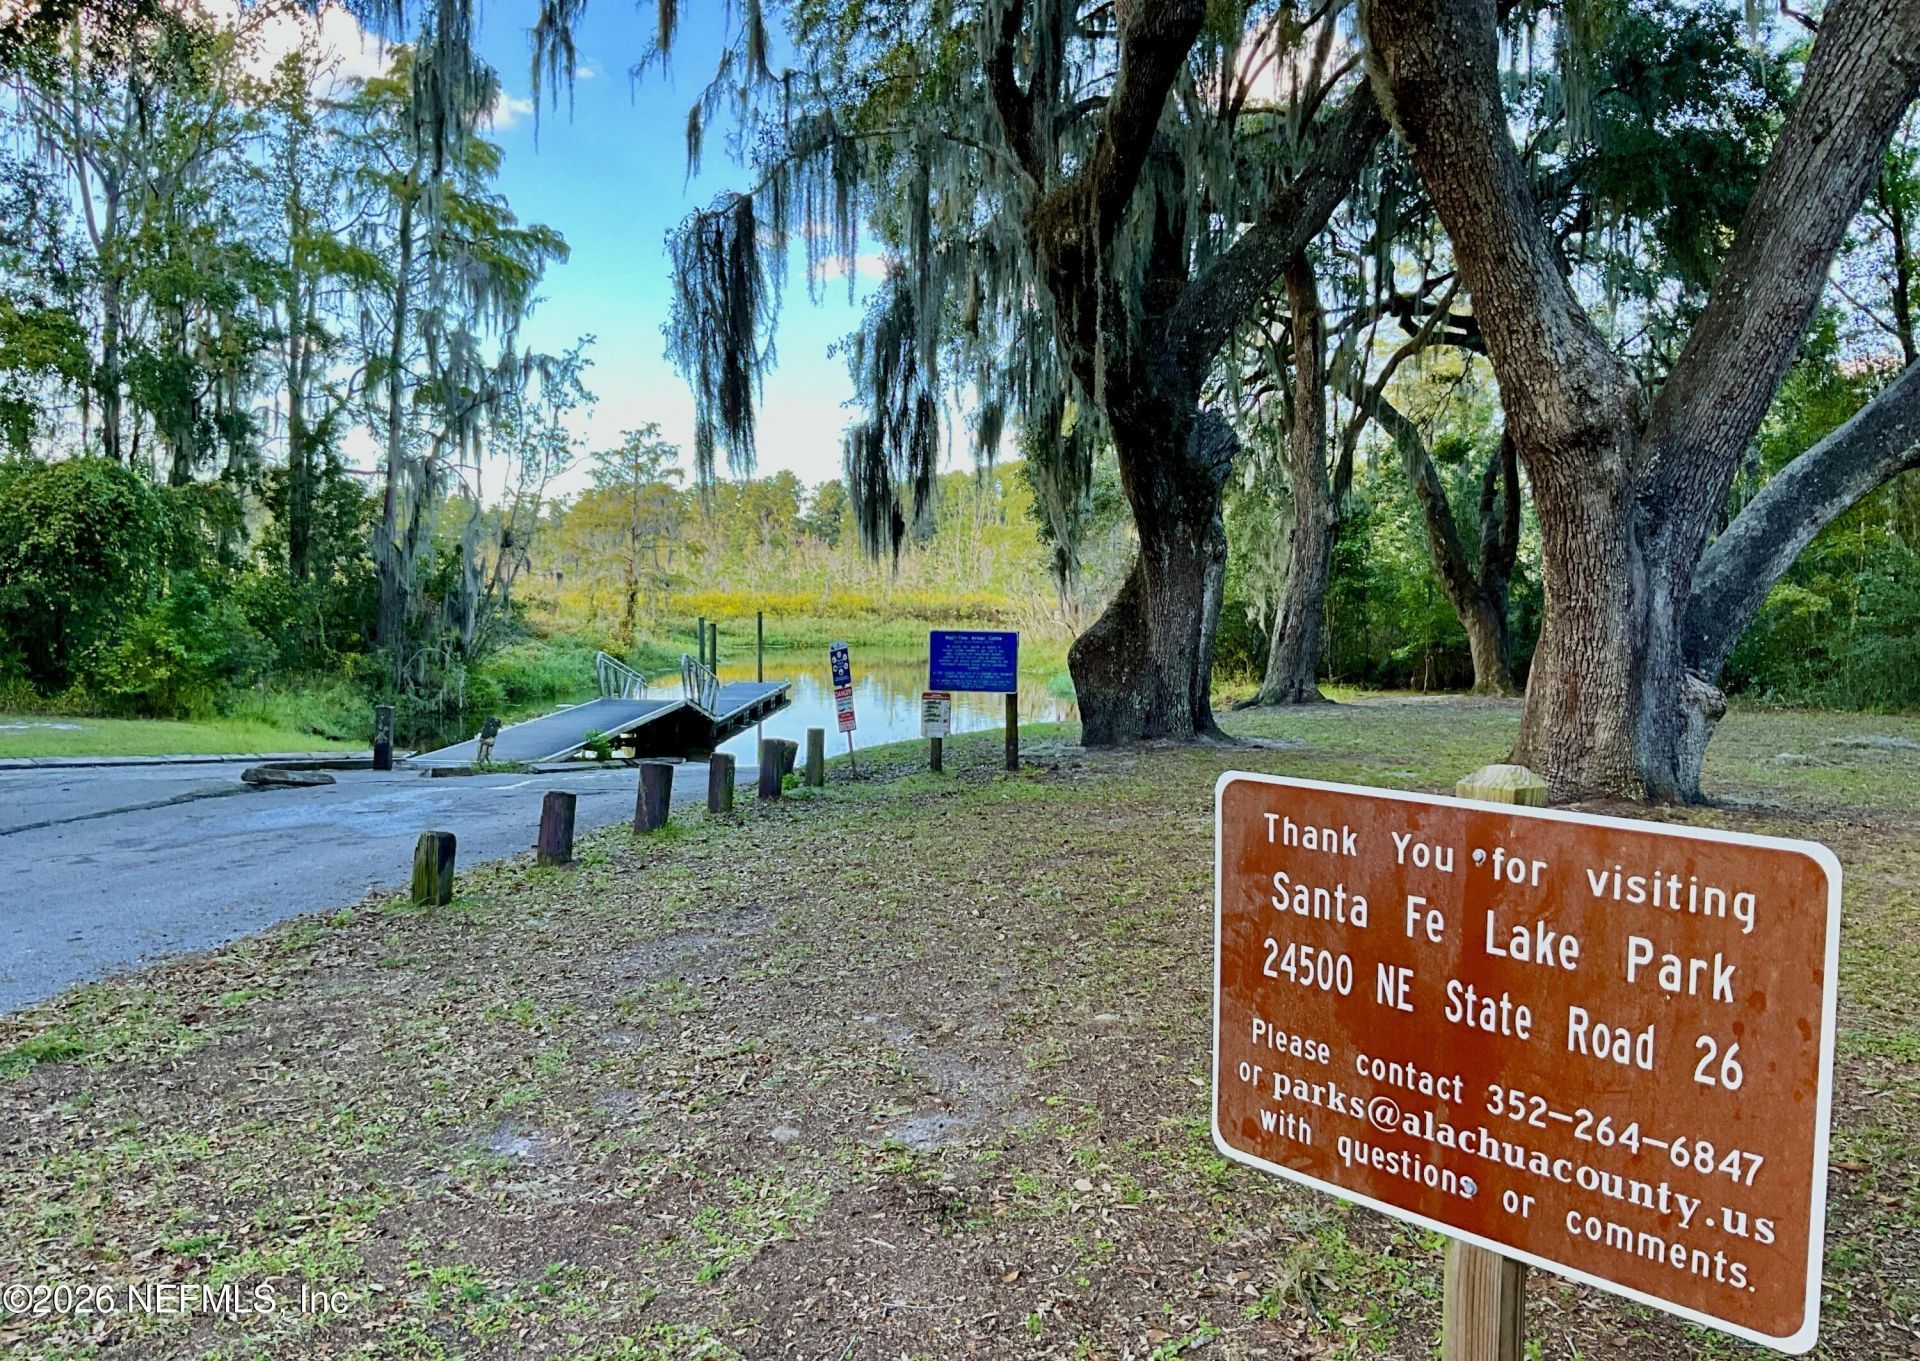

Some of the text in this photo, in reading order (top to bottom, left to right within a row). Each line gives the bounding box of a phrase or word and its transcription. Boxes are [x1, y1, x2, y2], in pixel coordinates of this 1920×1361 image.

[1264, 813, 1755, 934] Thank You for visiting
[1272, 872, 1736, 1003] Santa Fe Lake Park
[1252, 1017, 1330, 1064] Please
[1356, 1055, 1463, 1103] contact
[1264, 938, 1743, 1090] 24500 NE State Road 26
[1239, 1062, 1775, 1245] or parks@alachuacounty.us
[1260, 1109, 1755, 1292] with questions or comments.
